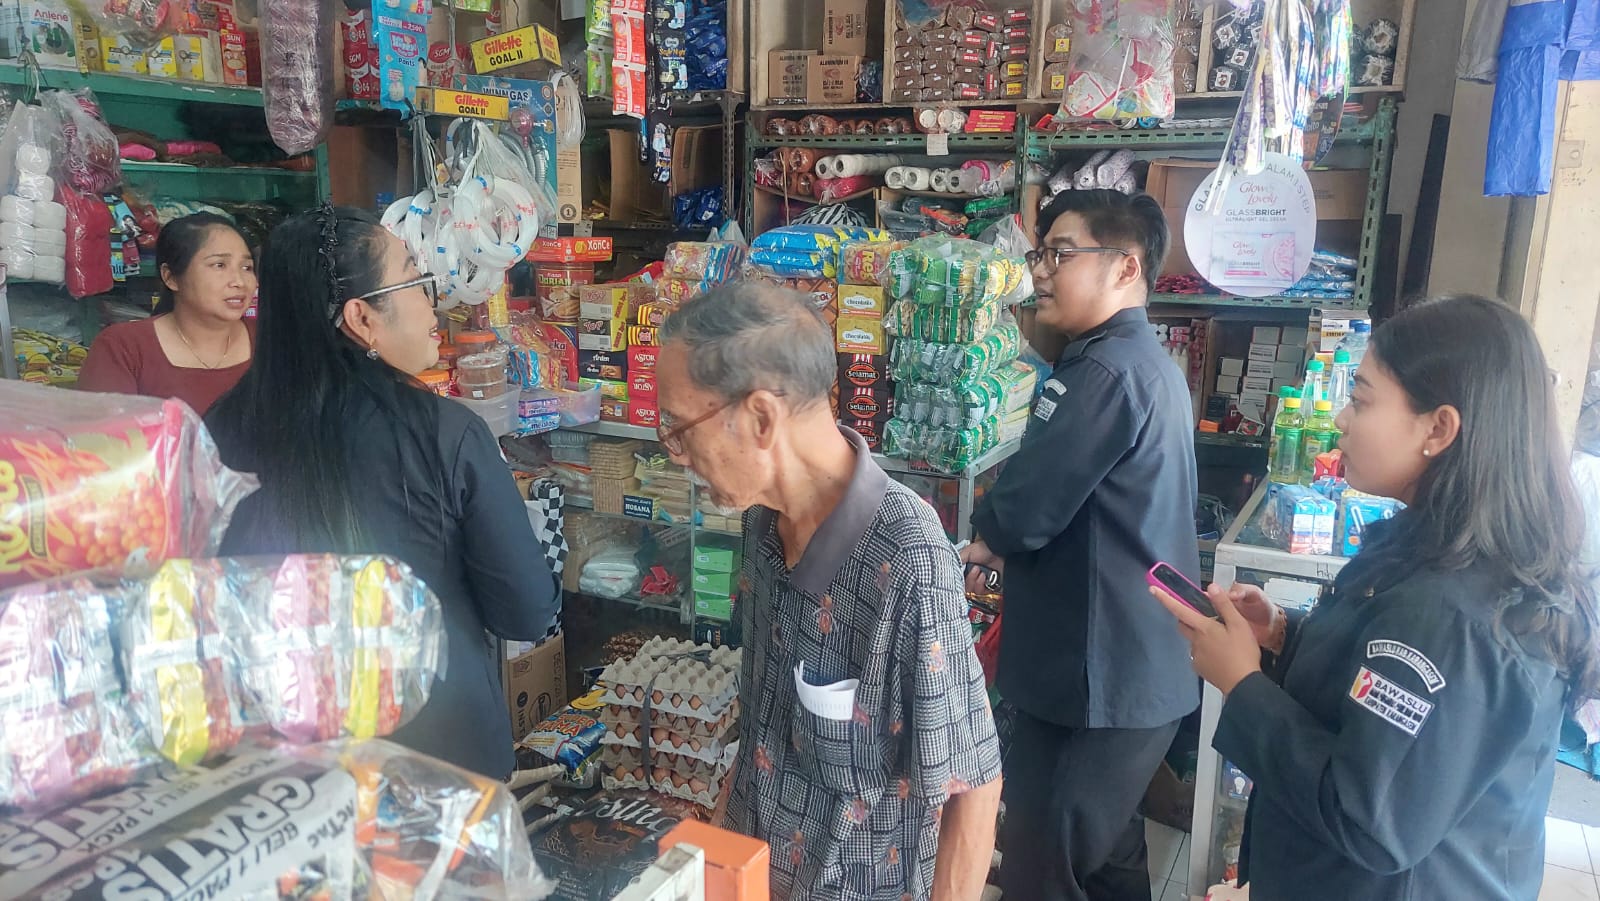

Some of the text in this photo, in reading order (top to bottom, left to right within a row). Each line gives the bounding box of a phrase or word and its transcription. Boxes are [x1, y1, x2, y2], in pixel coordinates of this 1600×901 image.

[34, 8, 69, 22] Anlene
[226, 34, 242, 42] SUN
[484, 34, 522, 56] Gillette
[398, 58, 416, 66] Pants
[489, 54, 516, 66] GOAL
[454, 94, 490, 108] Gillette
[510, 91, 529, 101] GAS
[458, 106, 480, 115] GOAL
[1240, 182, 1264, 194] Glow
[587, 240, 610, 250] XonCe
[584, 320, 604, 332] TOP
[634, 354, 656, 362] ASTOR
[848, 369, 877, 379] Selamat
[635, 408, 656, 417] ASTOR
[1374, 680, 1427, 713] BAWASLU
[76, 816, 140, 854] PACK
[102, 776, 317, 901] GRATIS
[252, 820, 300, 866] BELI
